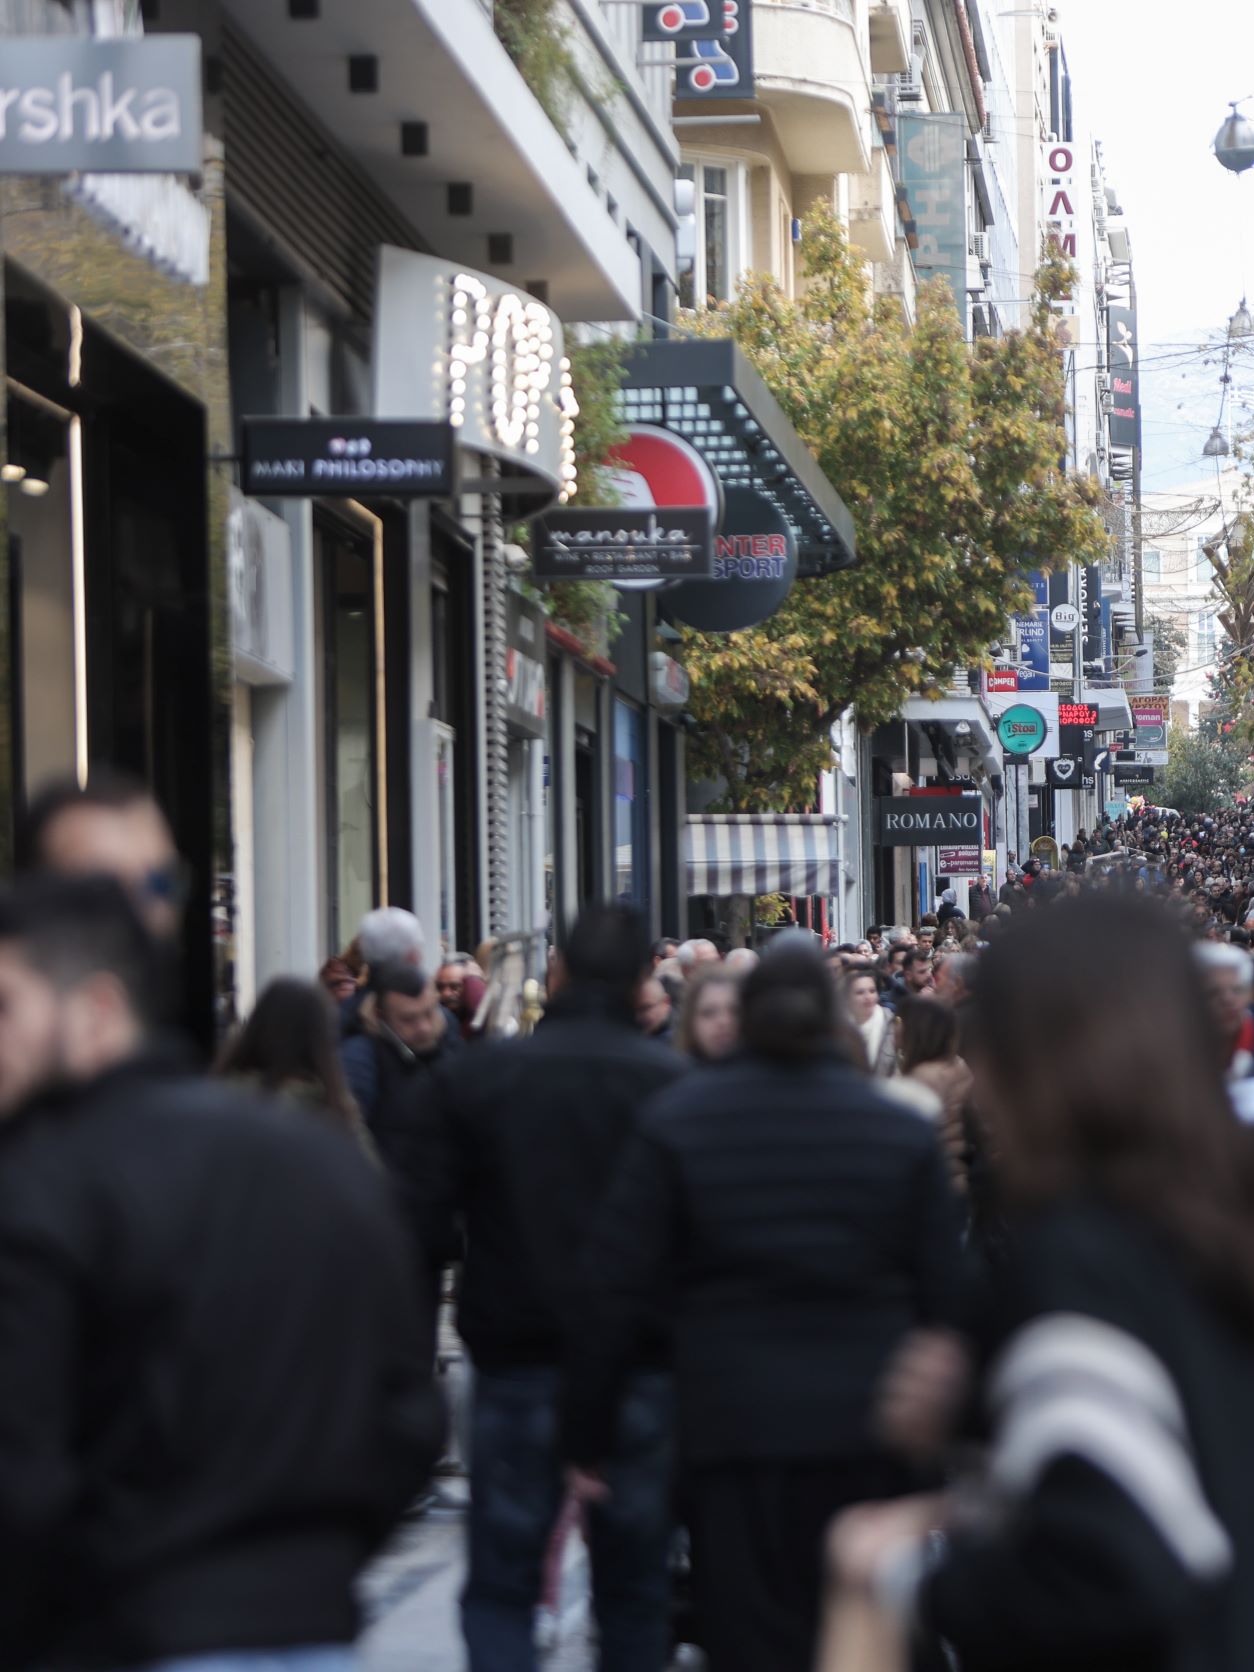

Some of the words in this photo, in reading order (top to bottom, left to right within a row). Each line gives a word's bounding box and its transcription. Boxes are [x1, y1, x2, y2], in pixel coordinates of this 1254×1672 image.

[311, 459, 444, 480] PHILOSOPHY
[550, 514, 692, 545] manouka
[592, 551, 658, 562] RESTAURANT
[712, 556, 786, 578] SPORT
[1055, 612, 1076, 623] Big
[886, 812, 978, 829] ROMANO
